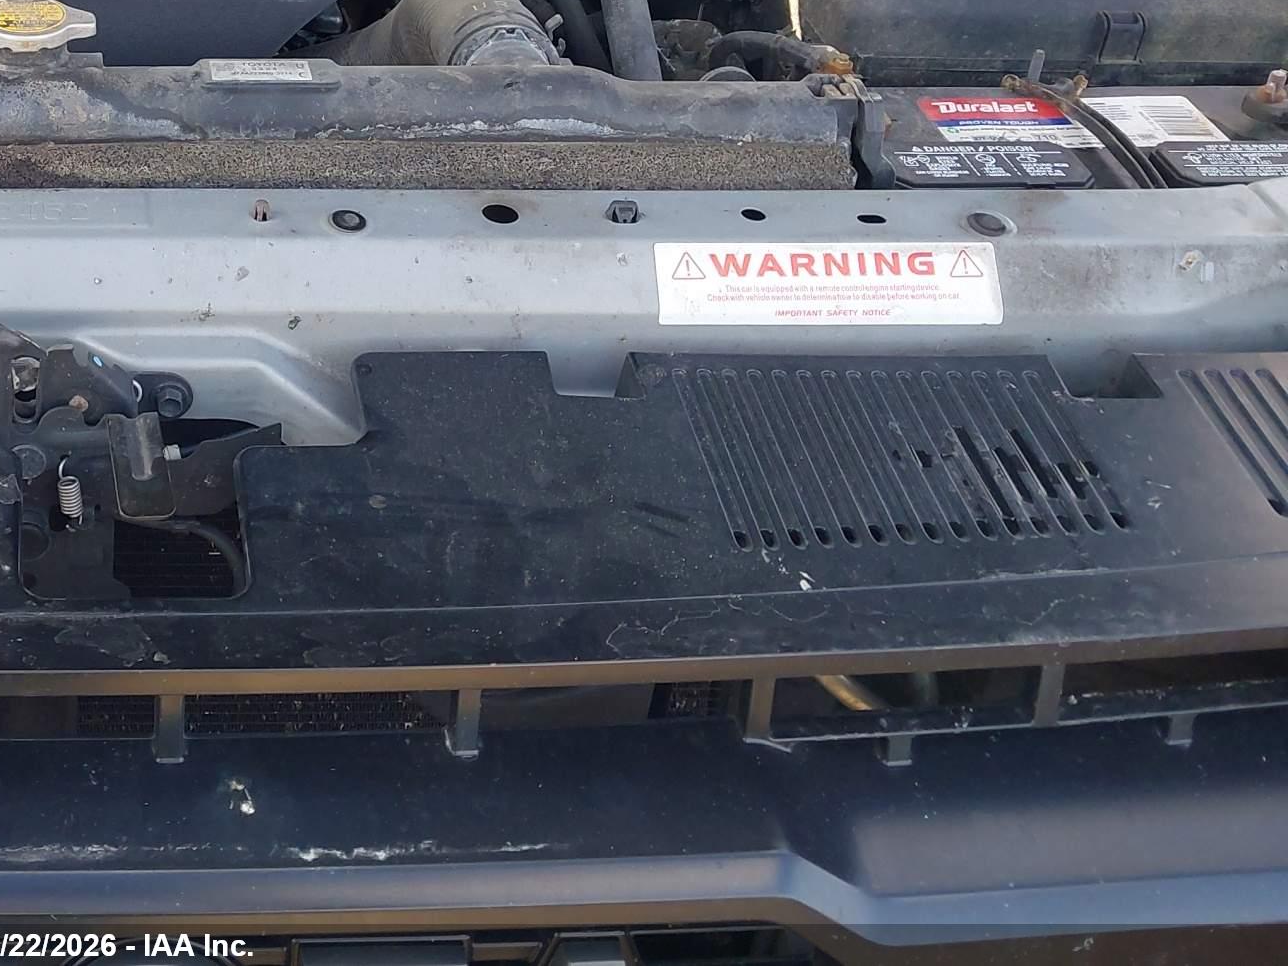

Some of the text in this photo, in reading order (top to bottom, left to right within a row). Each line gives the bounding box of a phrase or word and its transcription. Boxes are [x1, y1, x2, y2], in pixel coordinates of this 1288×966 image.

[931, 100, 1038, 114] Duralast
[709, 251, 936, 277] WARNING
[761, 285, 793, 295] equipped
[795, 285, 808, 293] with
[774, 308, 891, 317] IMPORTANT SAFETY NOTICE
